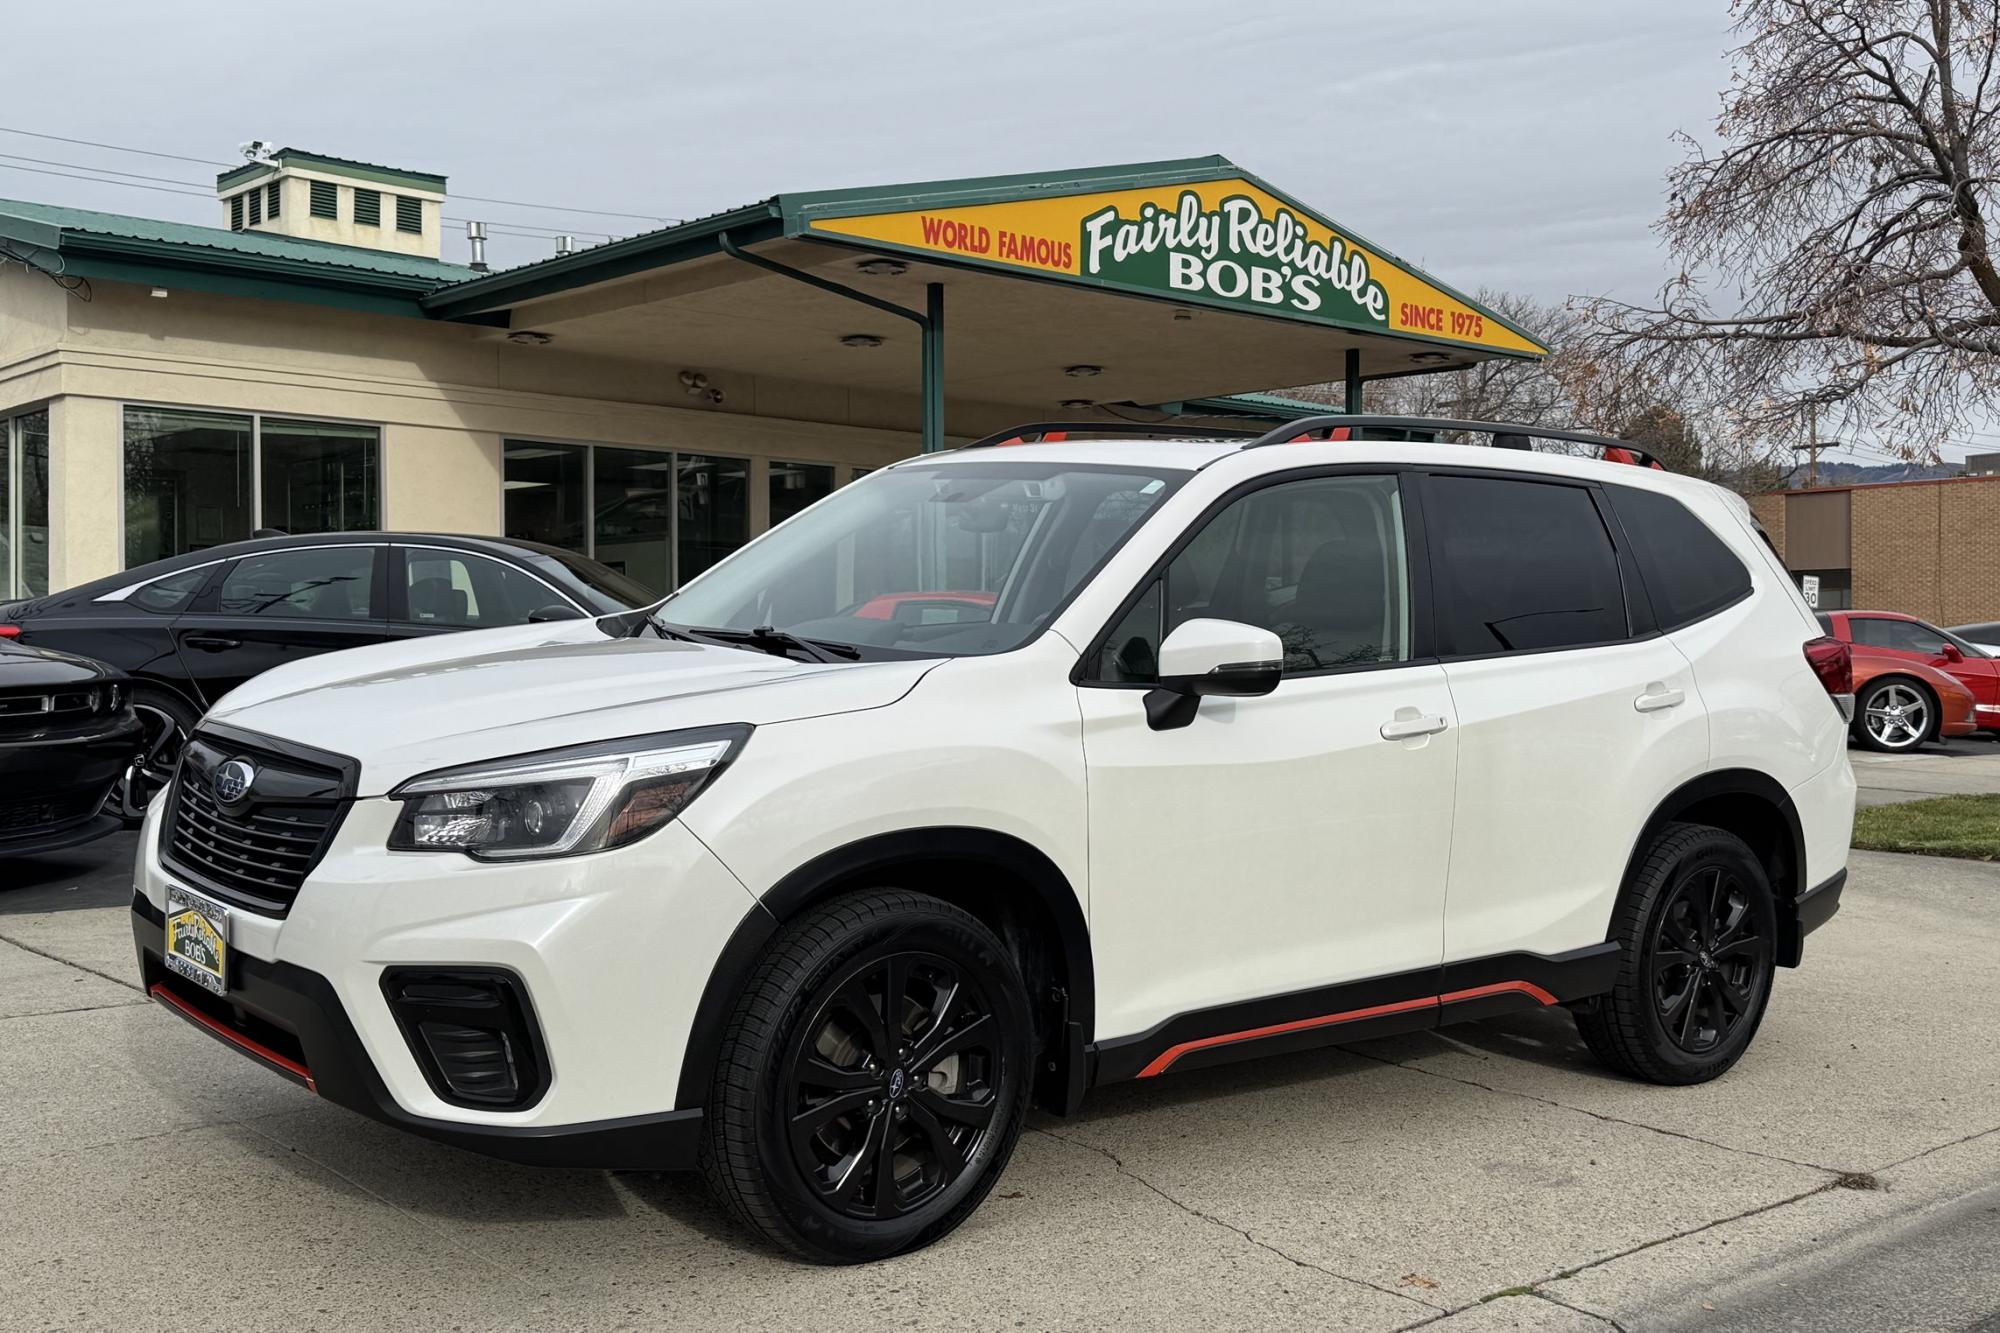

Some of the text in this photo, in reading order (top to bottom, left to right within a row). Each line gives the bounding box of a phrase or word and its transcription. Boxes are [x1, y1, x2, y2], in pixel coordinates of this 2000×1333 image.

[921, 215, 1073, 270] WORLD FAMOUS
[1086, 194, 1386, 321] Fairly Reliable
[1169, 251, 1322, 312] BOB'S
[1400, 302, 1483, 338] SINCE 1975
[1804, 592, 1817, 604] 30
[184, 939, 206, 965] BOB'S
